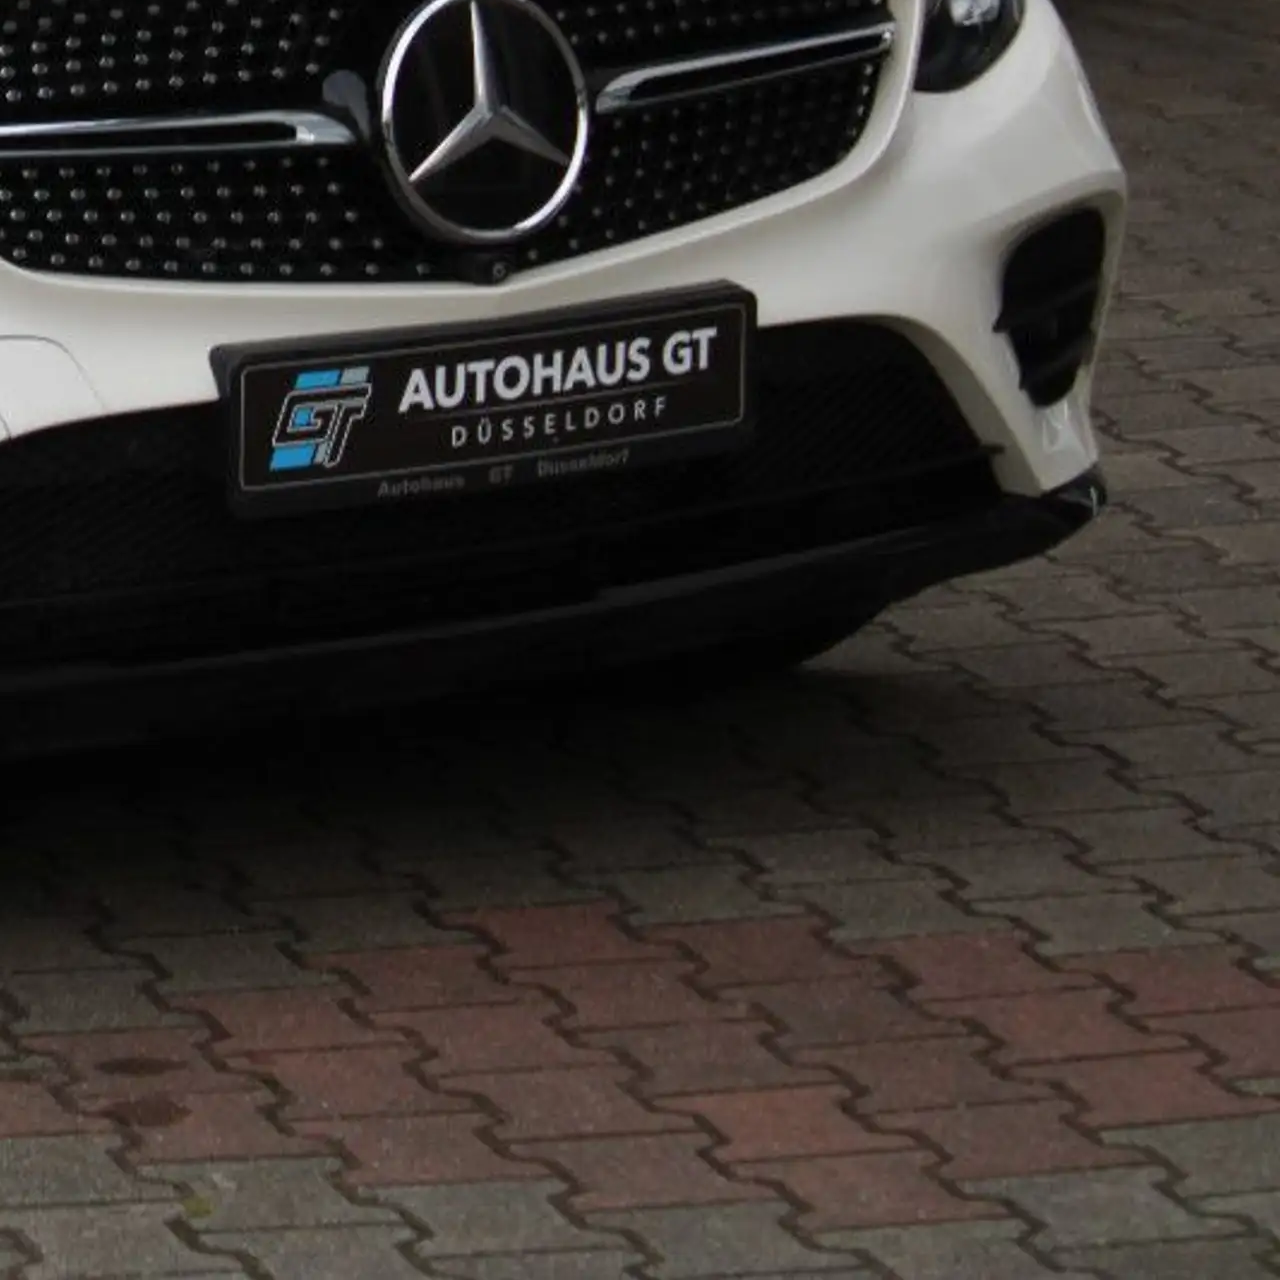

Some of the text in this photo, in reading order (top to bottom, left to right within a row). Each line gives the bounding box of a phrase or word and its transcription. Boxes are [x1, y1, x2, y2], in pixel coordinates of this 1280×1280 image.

[397, 326, 718, 414] AUTOHAUS GT
[451, 395, 667, 449] DÜSSELDORF
